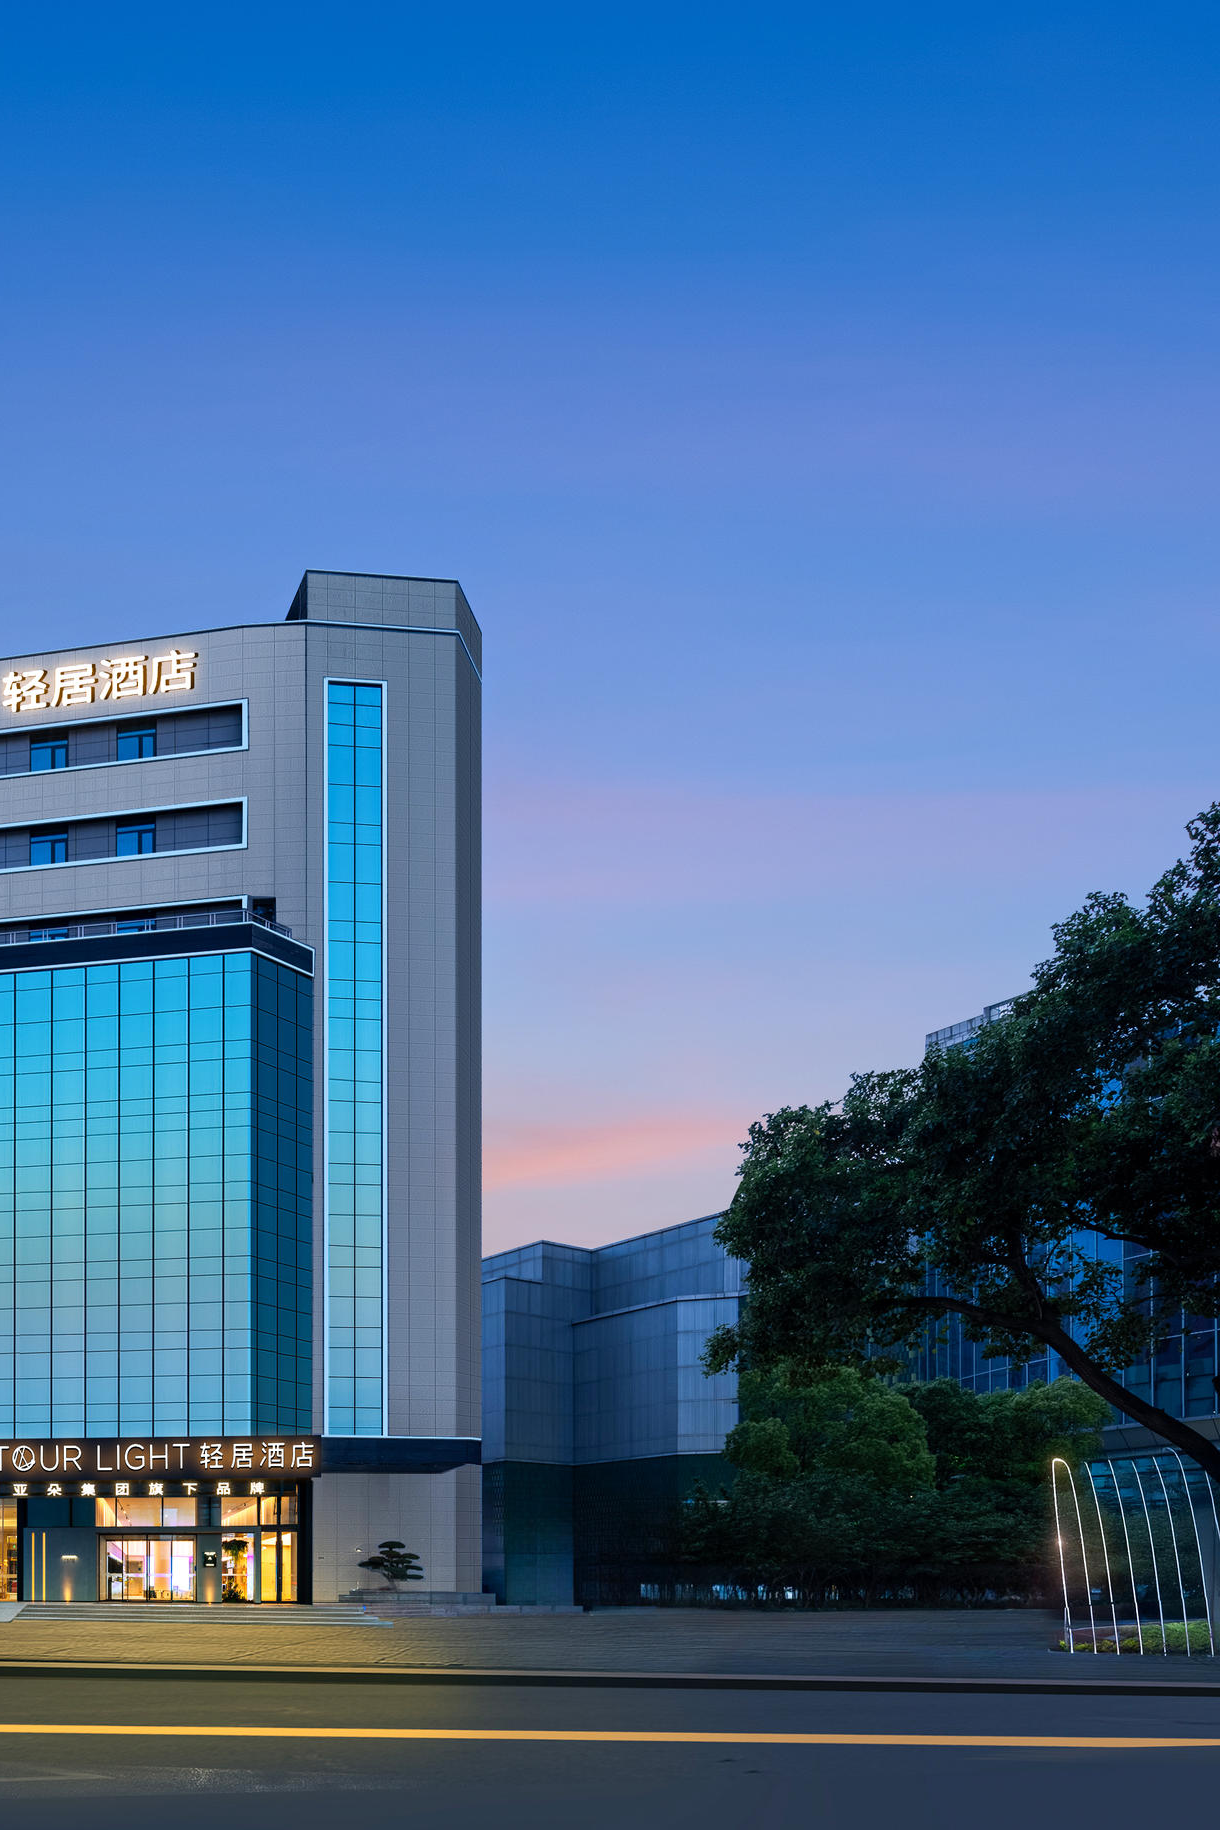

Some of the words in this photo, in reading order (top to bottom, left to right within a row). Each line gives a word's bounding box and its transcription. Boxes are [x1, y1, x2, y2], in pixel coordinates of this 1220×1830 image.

[2, 649, 198, 713] 轻居酒店
[96, 1443, 191, 1471] LIGHT
[199, 1441, 315, 1469] 轻居酒店
[12, 1482, 266, 1497] 亚朵集团旗下品牌
